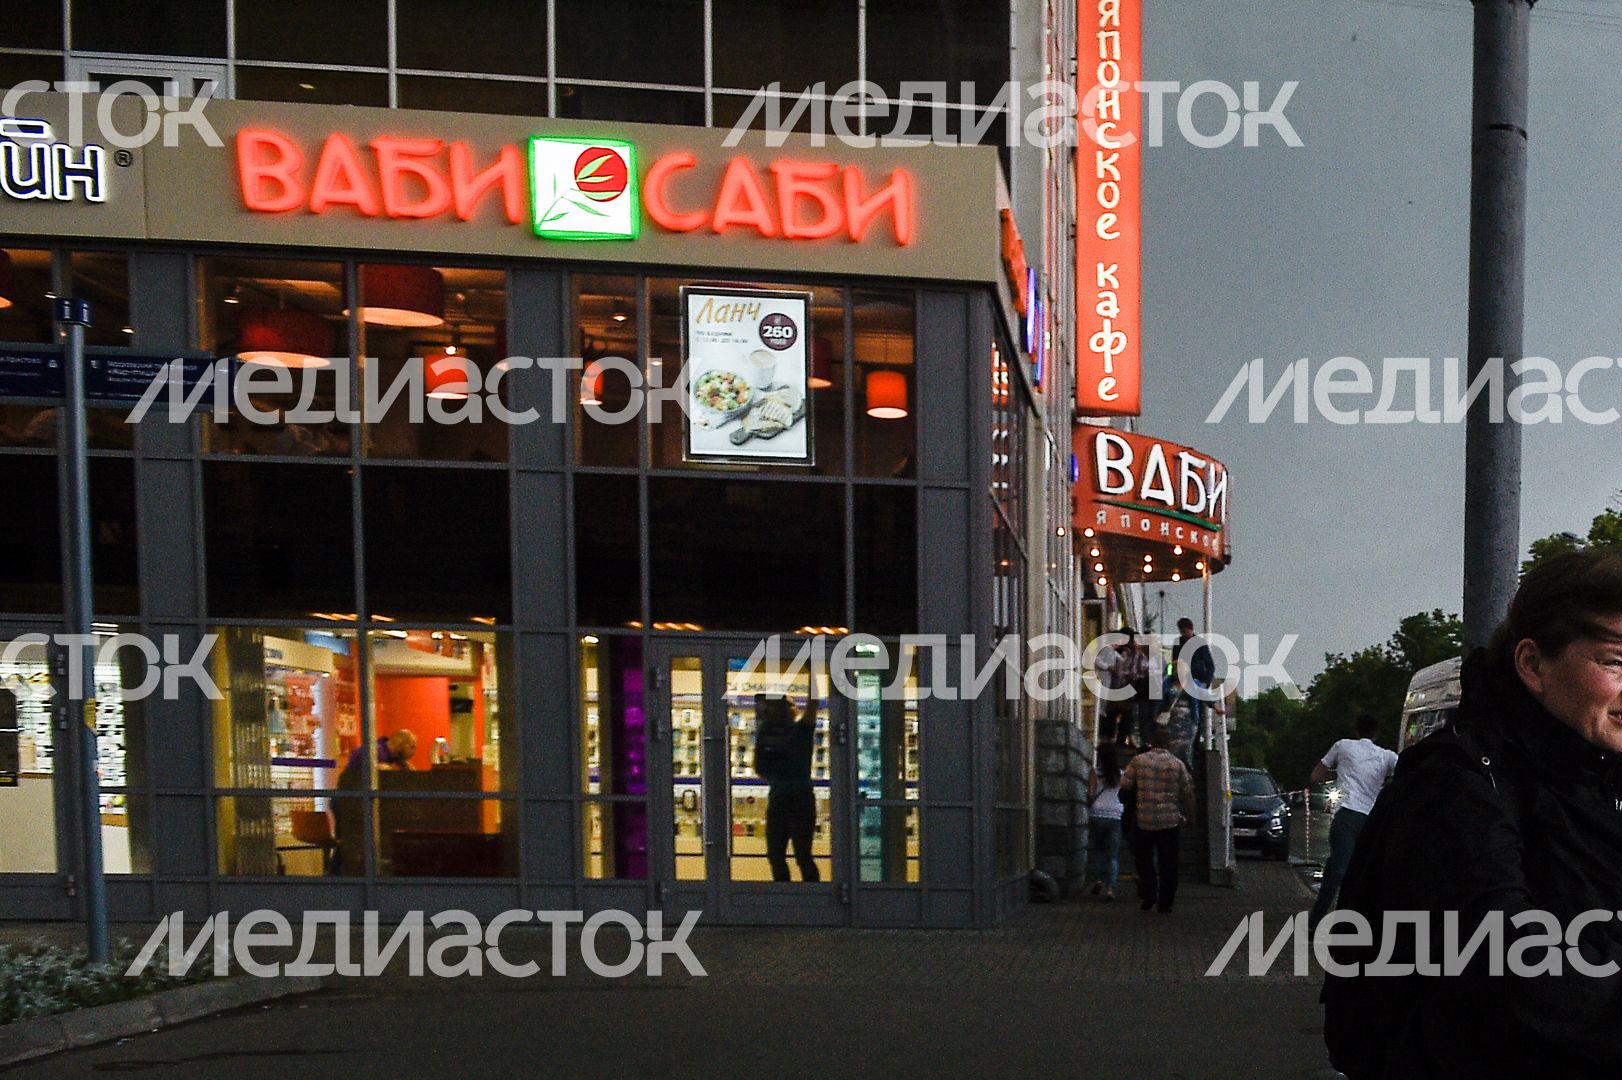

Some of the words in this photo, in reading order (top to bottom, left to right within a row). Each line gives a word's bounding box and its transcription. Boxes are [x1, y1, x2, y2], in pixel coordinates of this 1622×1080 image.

[236, 129, 522, 224] ВАБИ
[645, 152, 914, 246] САБИ
[695, 298, 761, 324] Ланч
[1095, 431, 1228, 522] ВАБИ
